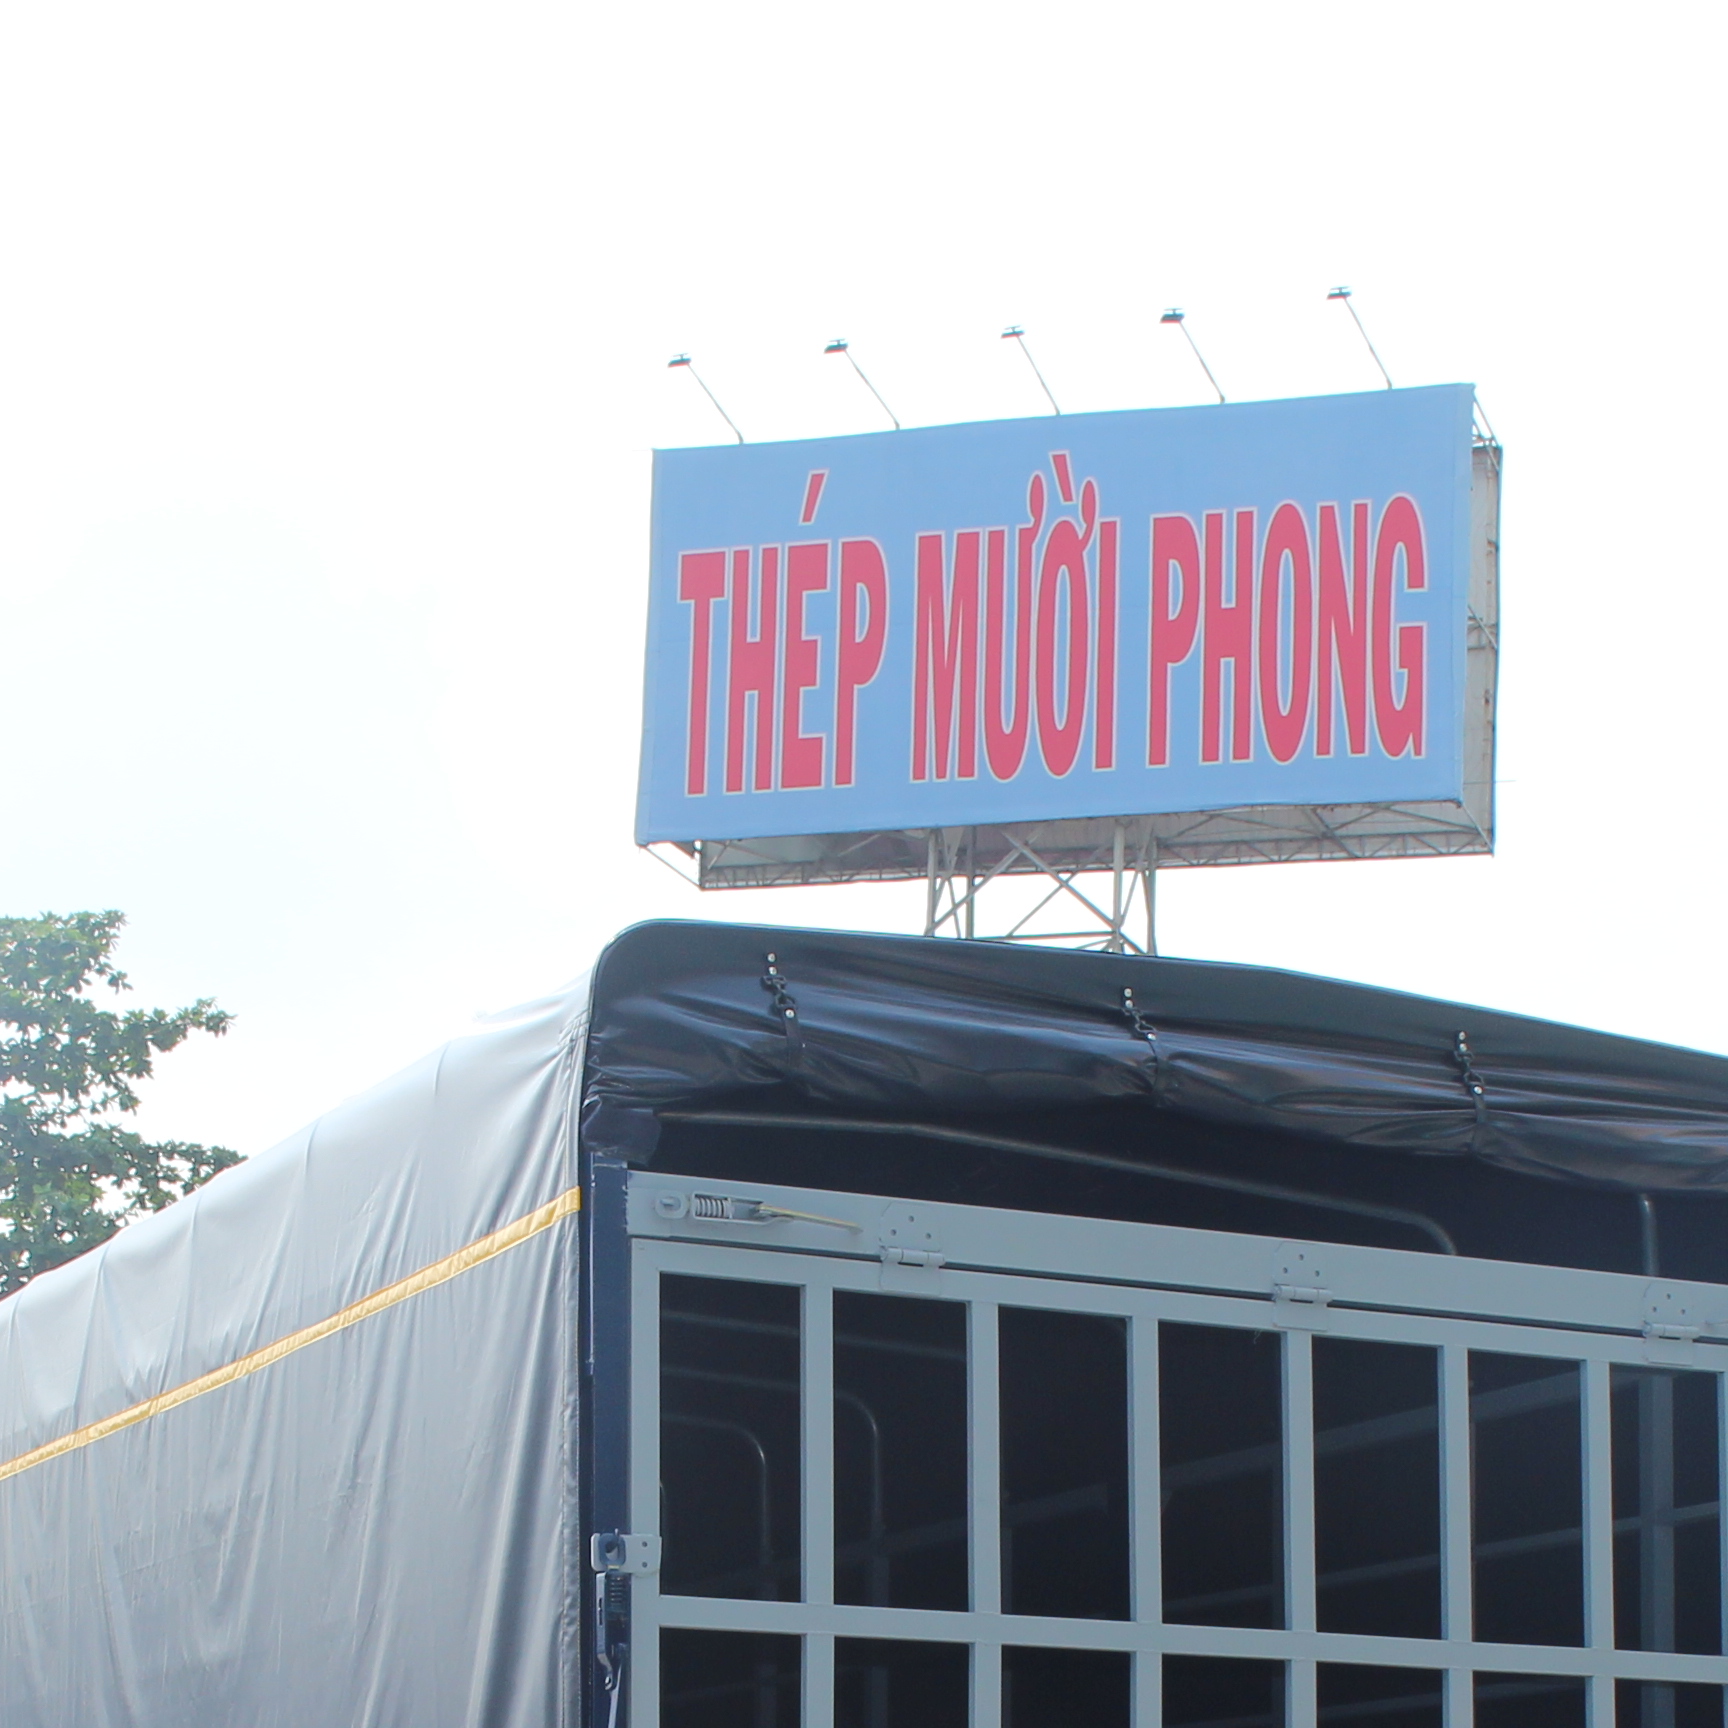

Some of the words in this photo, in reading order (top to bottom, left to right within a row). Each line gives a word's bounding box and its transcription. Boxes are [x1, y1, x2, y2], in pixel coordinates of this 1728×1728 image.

[678, 468, 889, 797] THÉP
[910, 451, 1120, 783] MƯỜI
[1145, 495, 1428, 768] PHONG
